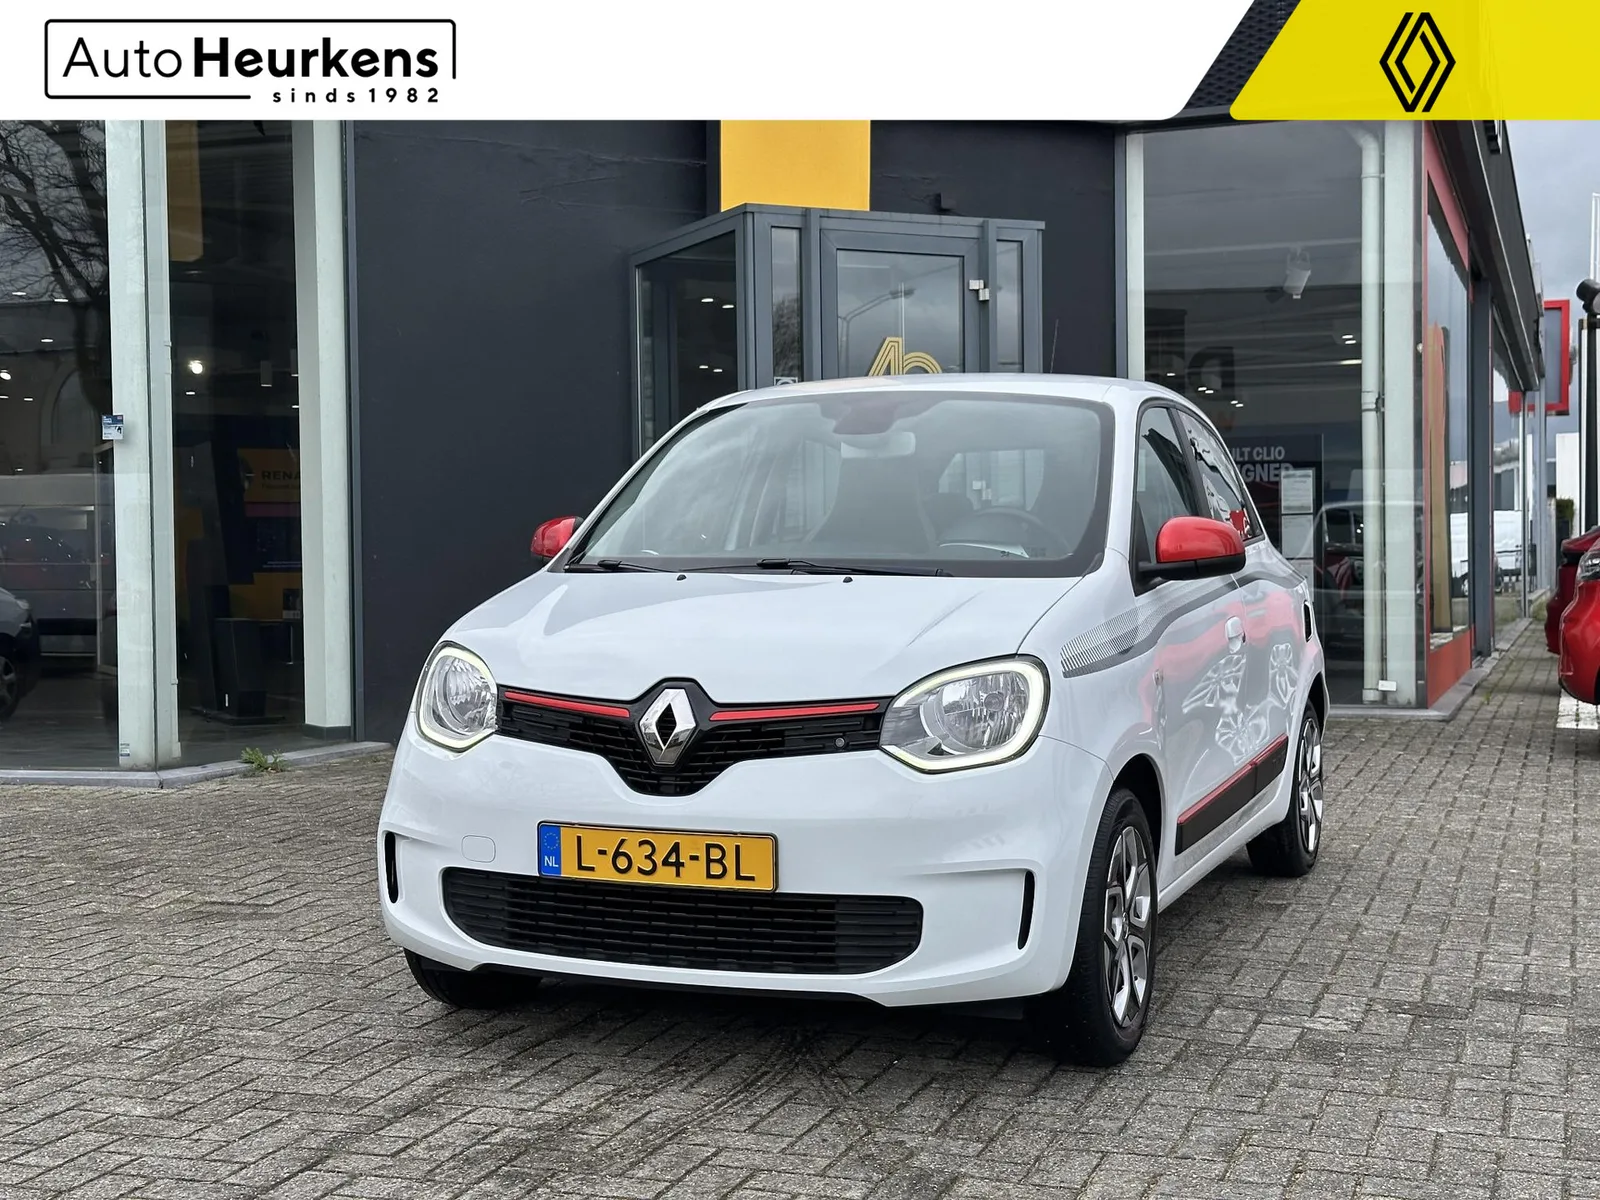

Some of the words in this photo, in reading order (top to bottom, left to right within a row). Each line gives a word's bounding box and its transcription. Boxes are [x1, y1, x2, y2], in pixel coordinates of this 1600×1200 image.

[1252, 446, 1286, 460] CLIO
[544, 855, 559, 868] NL
[576, 834, 756, 882] L-634-BL
